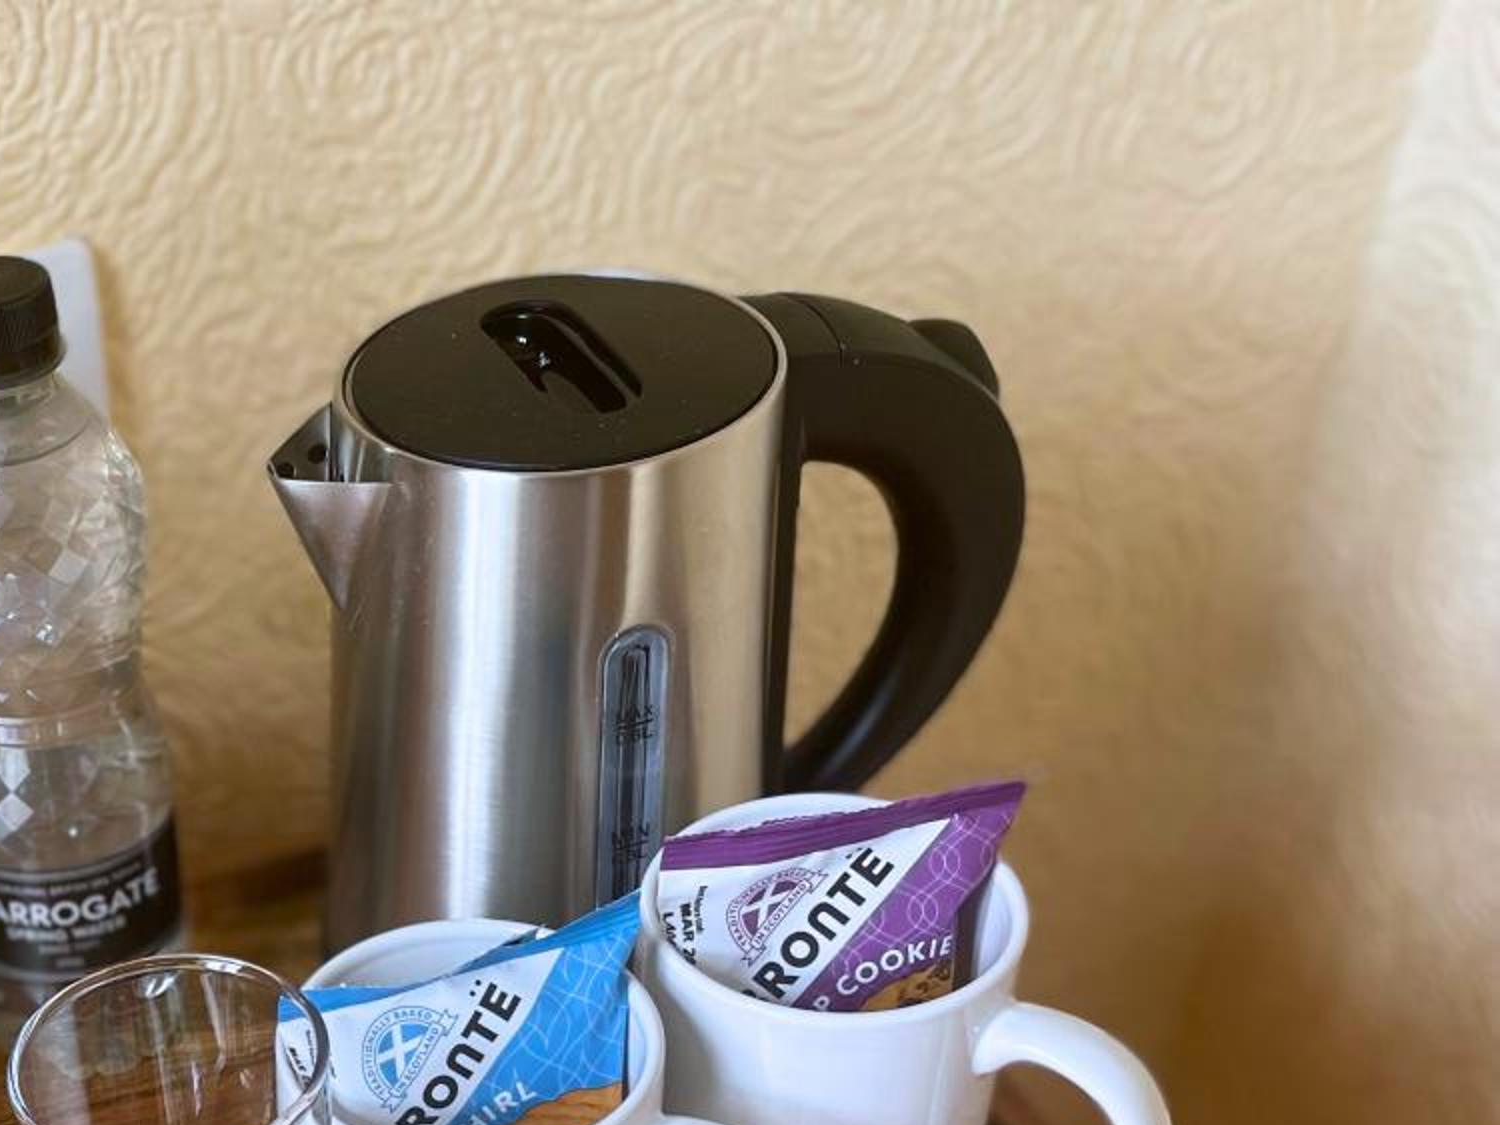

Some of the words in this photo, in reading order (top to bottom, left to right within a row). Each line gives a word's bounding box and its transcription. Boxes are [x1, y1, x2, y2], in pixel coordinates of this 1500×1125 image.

[740, 847, 894, 1001] RONTË
[764, 882, 807, 932] SCOTLAND
[836, 935, 953, 996] COOKIE
[403, 1026, 441, 1084] SCOTLAND
